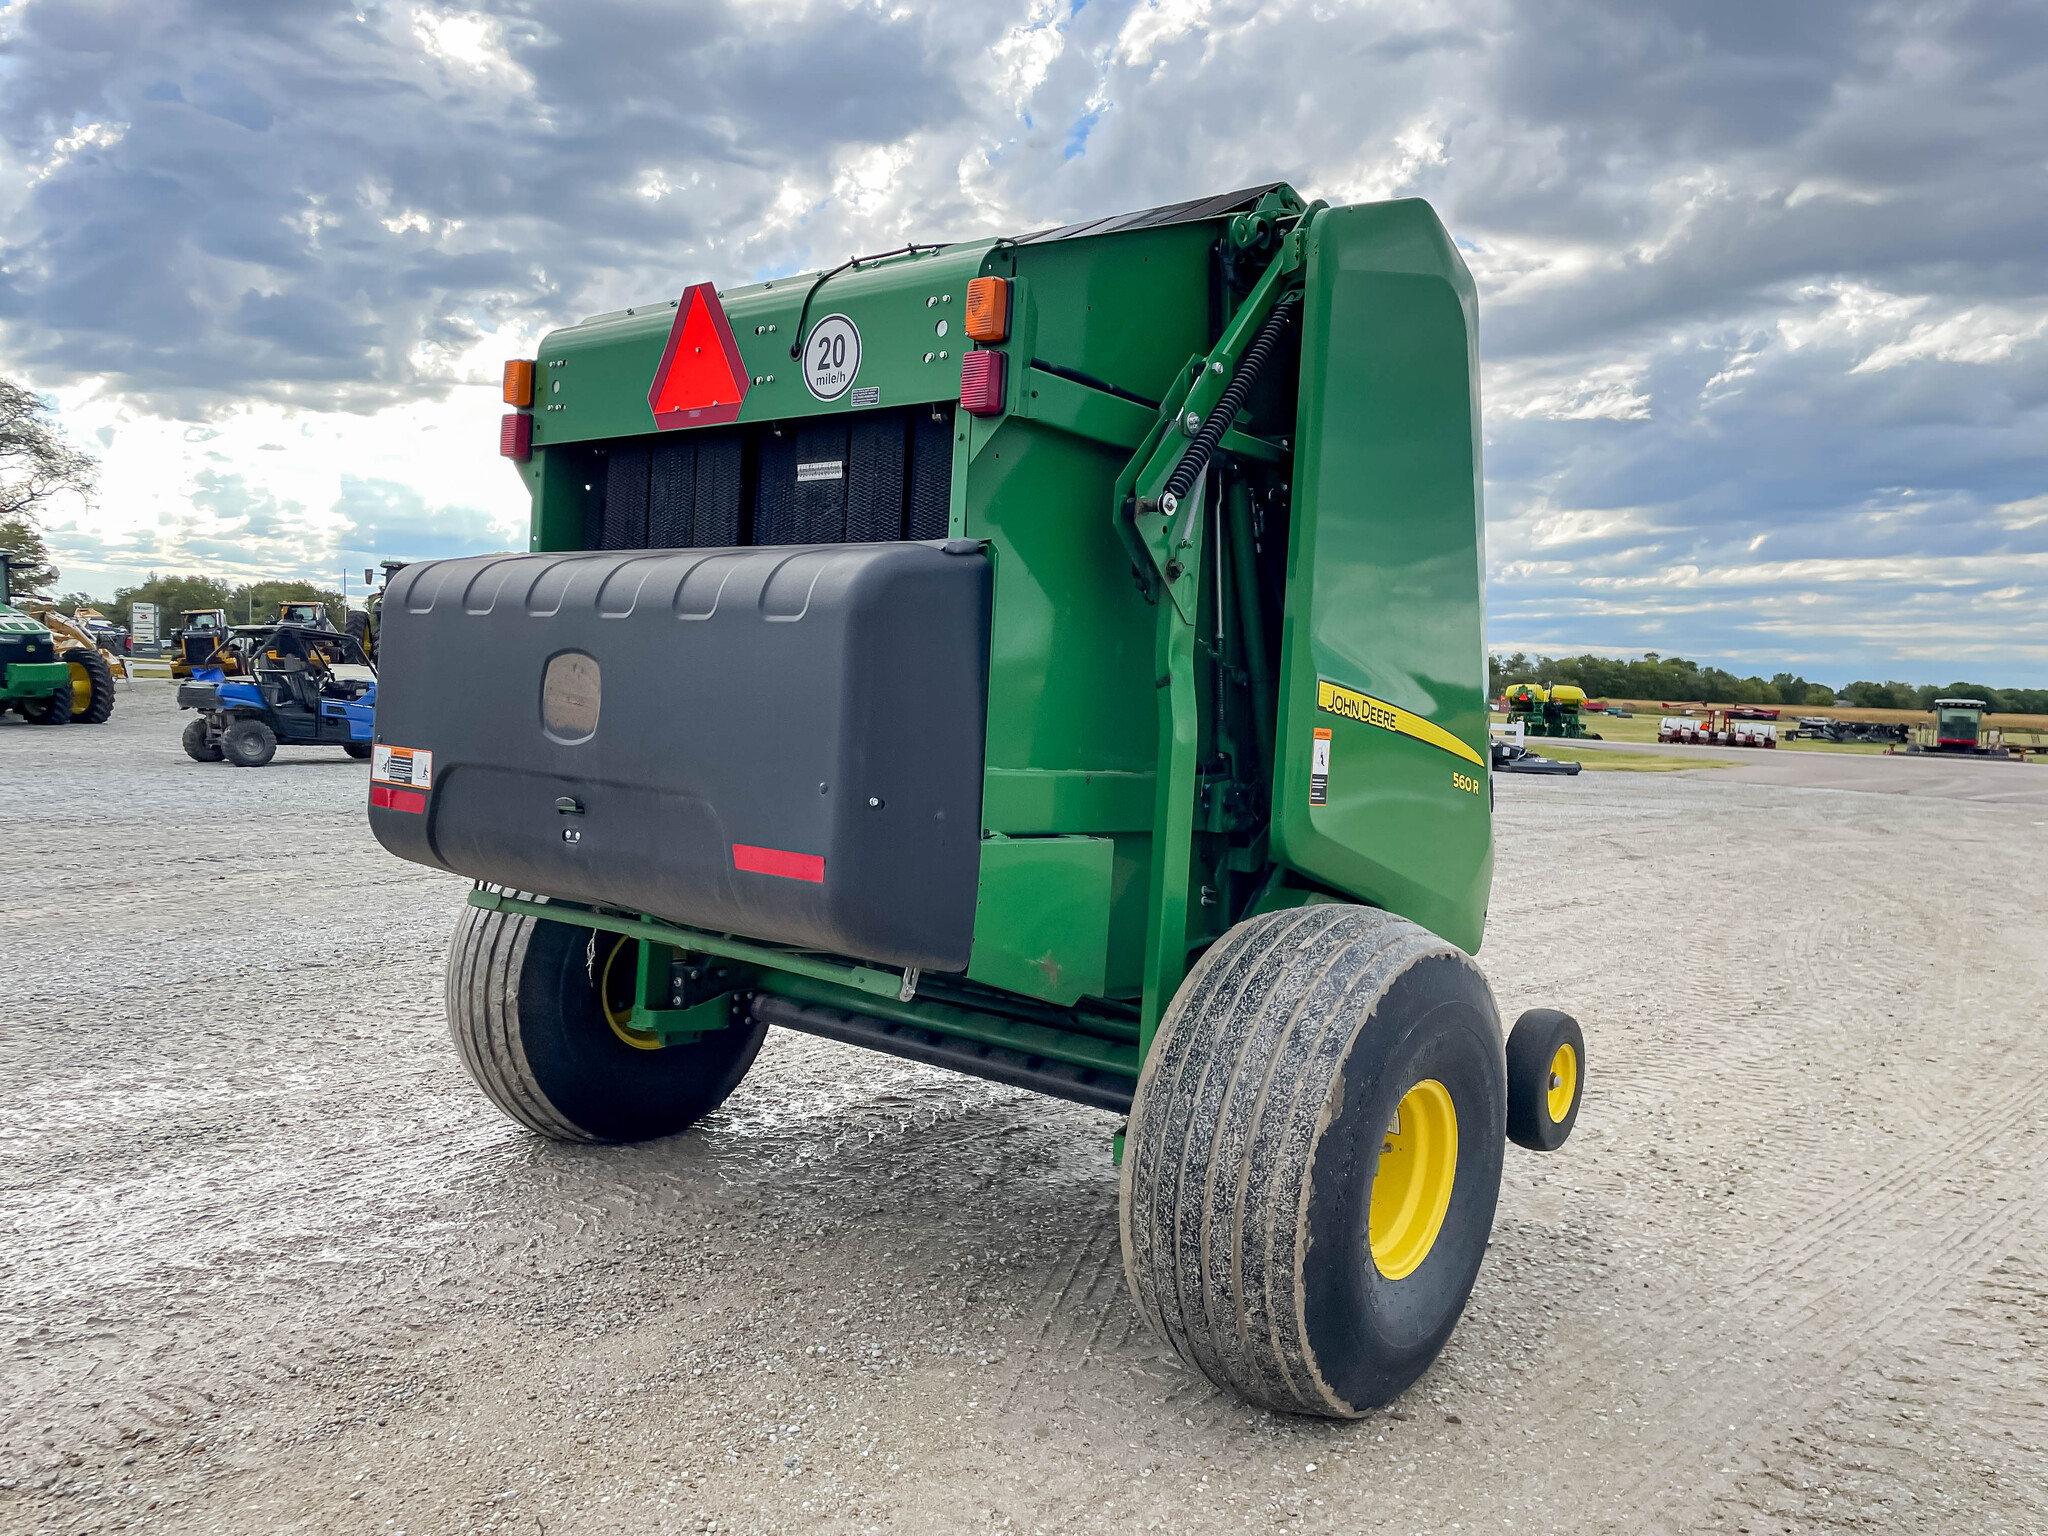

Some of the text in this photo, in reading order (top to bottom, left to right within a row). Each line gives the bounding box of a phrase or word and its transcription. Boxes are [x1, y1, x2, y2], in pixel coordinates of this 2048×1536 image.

[817, 334, 846, 370] 20
[816, 371, 846, 386] mile/h
[1327, 690, 1397, 729] JOHN DEERE
